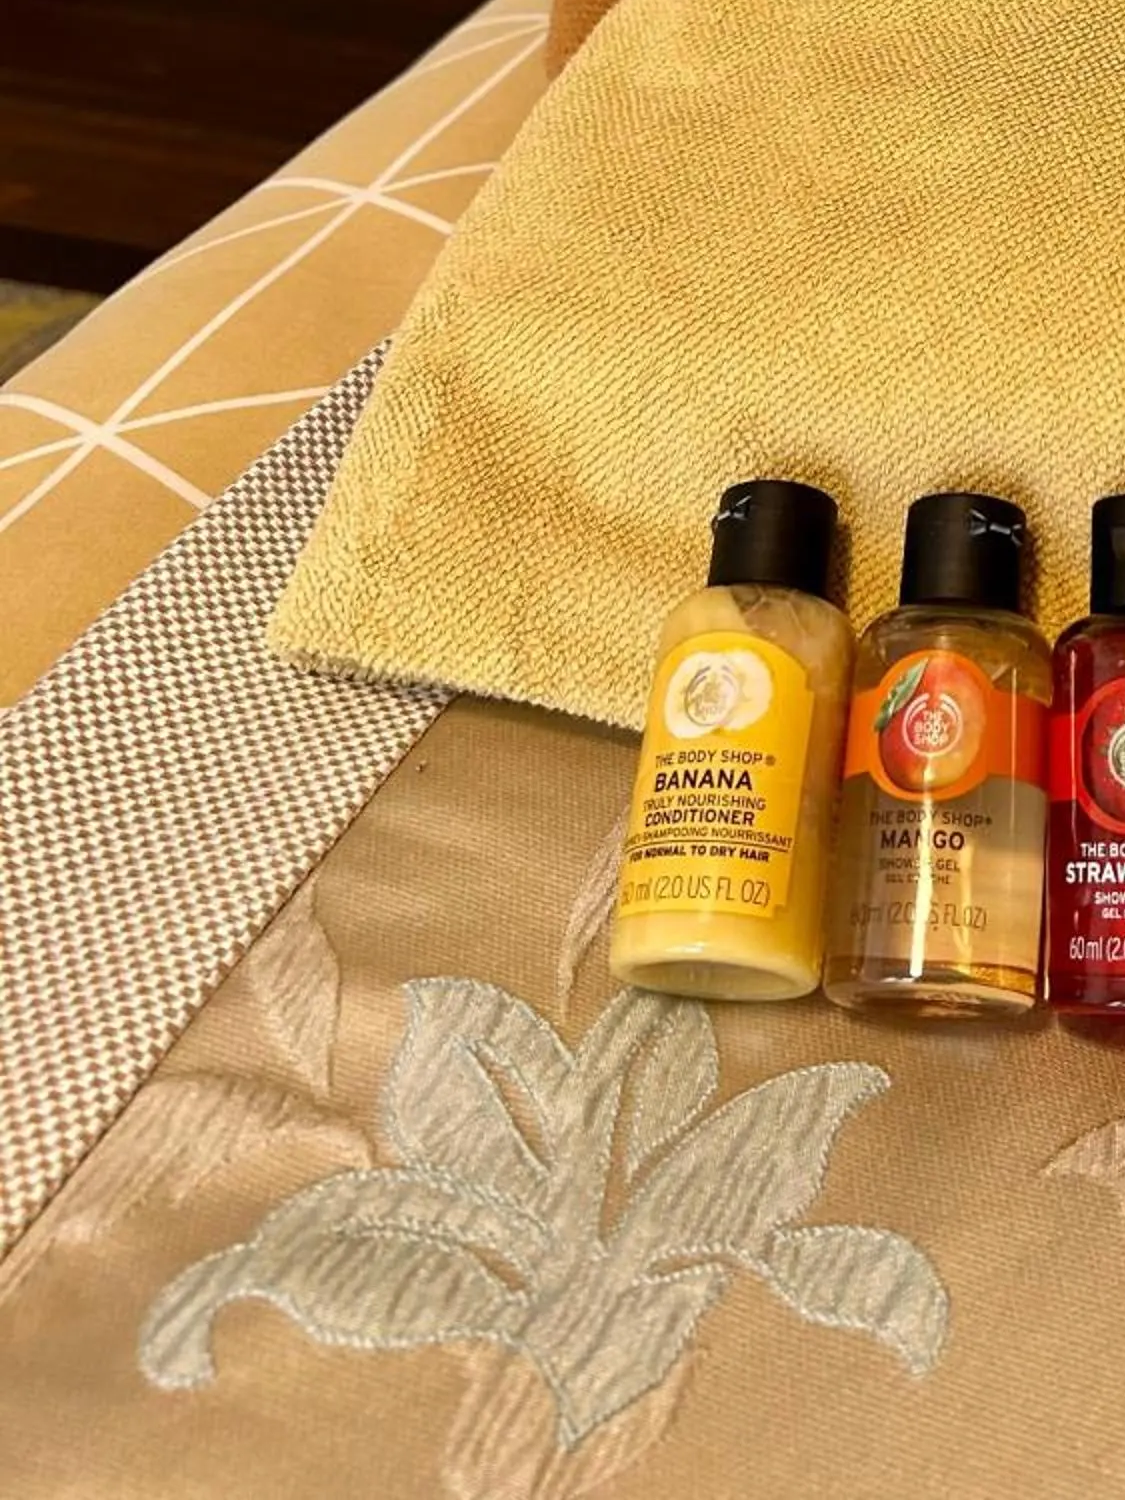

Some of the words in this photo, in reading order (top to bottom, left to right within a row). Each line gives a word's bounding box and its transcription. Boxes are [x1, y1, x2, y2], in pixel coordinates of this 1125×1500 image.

[922, 710, 945, 721] THE
[914, 721, 951, 733] BODY
[655, 754, 674, 769] THE
[677, 750, 717, 765] BODY
[654, 768, 754, 793] BANANA
[643, 796, 675, 813] TRULY
[676, 793, 767, 812] NOURISHING
[645, 808, 756, 828] CONDITIONER
[870, 810, 894, 826] THE
[711, 827, 793, 849] NOURRISSANT
[644, 845, 687, 860] NORMAL
[690, 844, 706, 856] TO
[709, 845, 736, 858] DRY
[739, 847, 770, 862] HAIR
[1080, 842, 1106, 857] THE
[935, 858, 960, 873] GEL
[687, 874, 712, 900] US
[715, 875, 736, 902] FL
[740, 878, 771, 908] OZ)
[943, 902, 961, 927] FL
[1101, 907, 1121, 920] GEL
